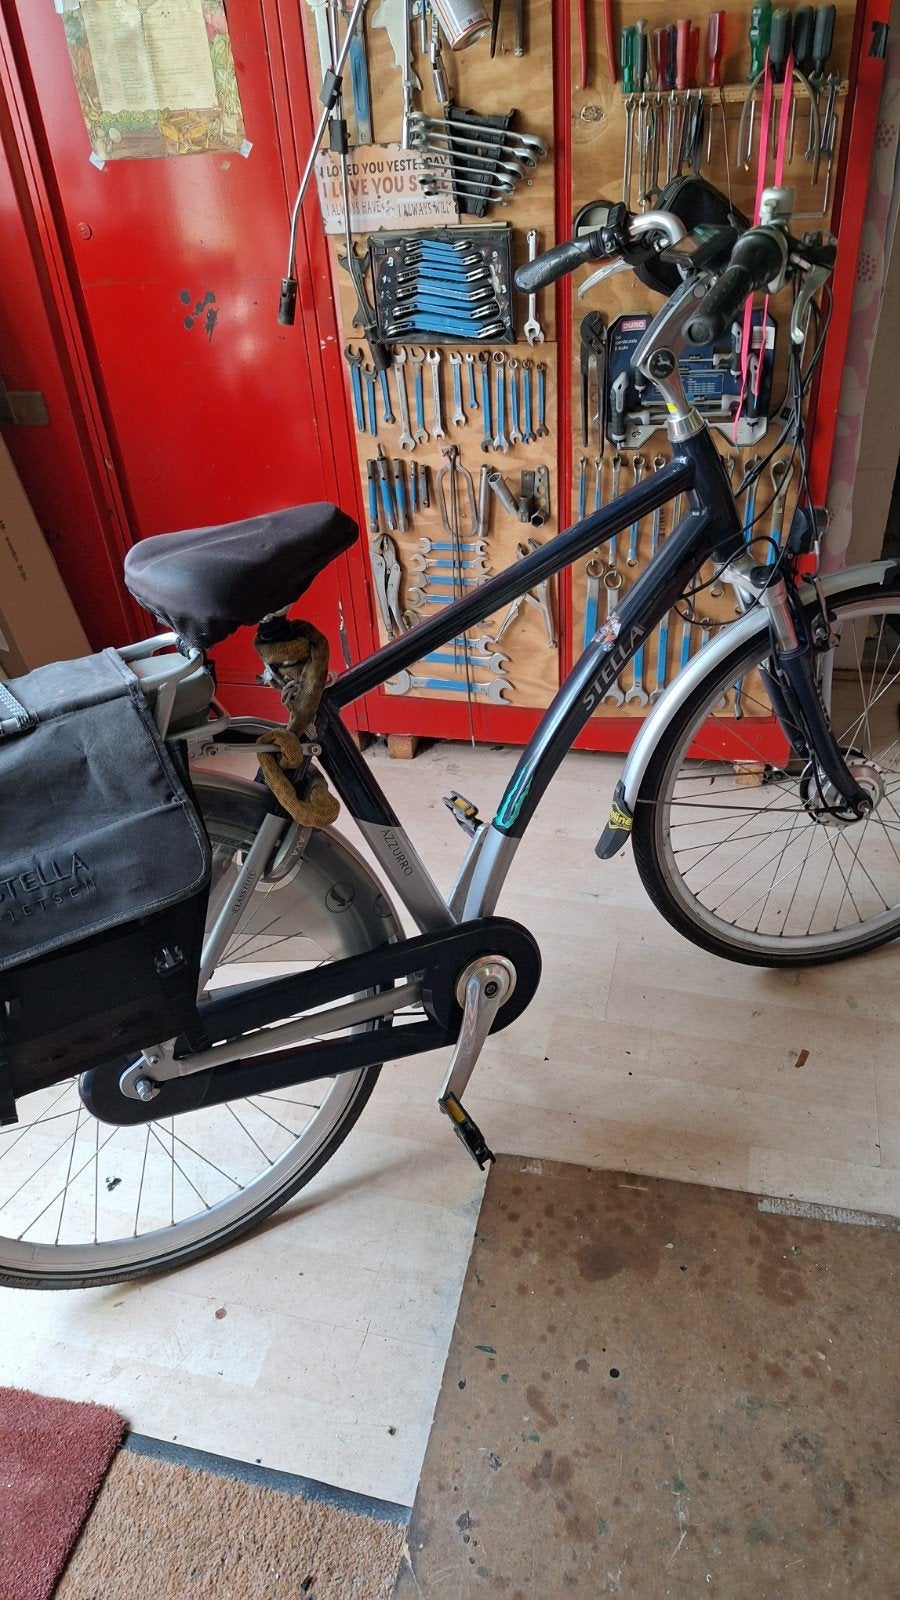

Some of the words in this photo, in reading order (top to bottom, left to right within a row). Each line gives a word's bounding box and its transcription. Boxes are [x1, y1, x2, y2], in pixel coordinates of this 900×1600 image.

[322, 181, 328, 198] I
[371, 174, 405, 196] YOU
[408, 172, 449, 192] SLL
[361, 161, 384, 174] YOU
[386, 156, 448, 172] YESTEDAY
[623, 320, 645, 330] DURO
[582, 623, 646, 711] STELLA
[380, 829, 413, 876] AZZURRO
[0, 851, 90, 904] TELLA
[0, 878, 98, 922] IETSEN
